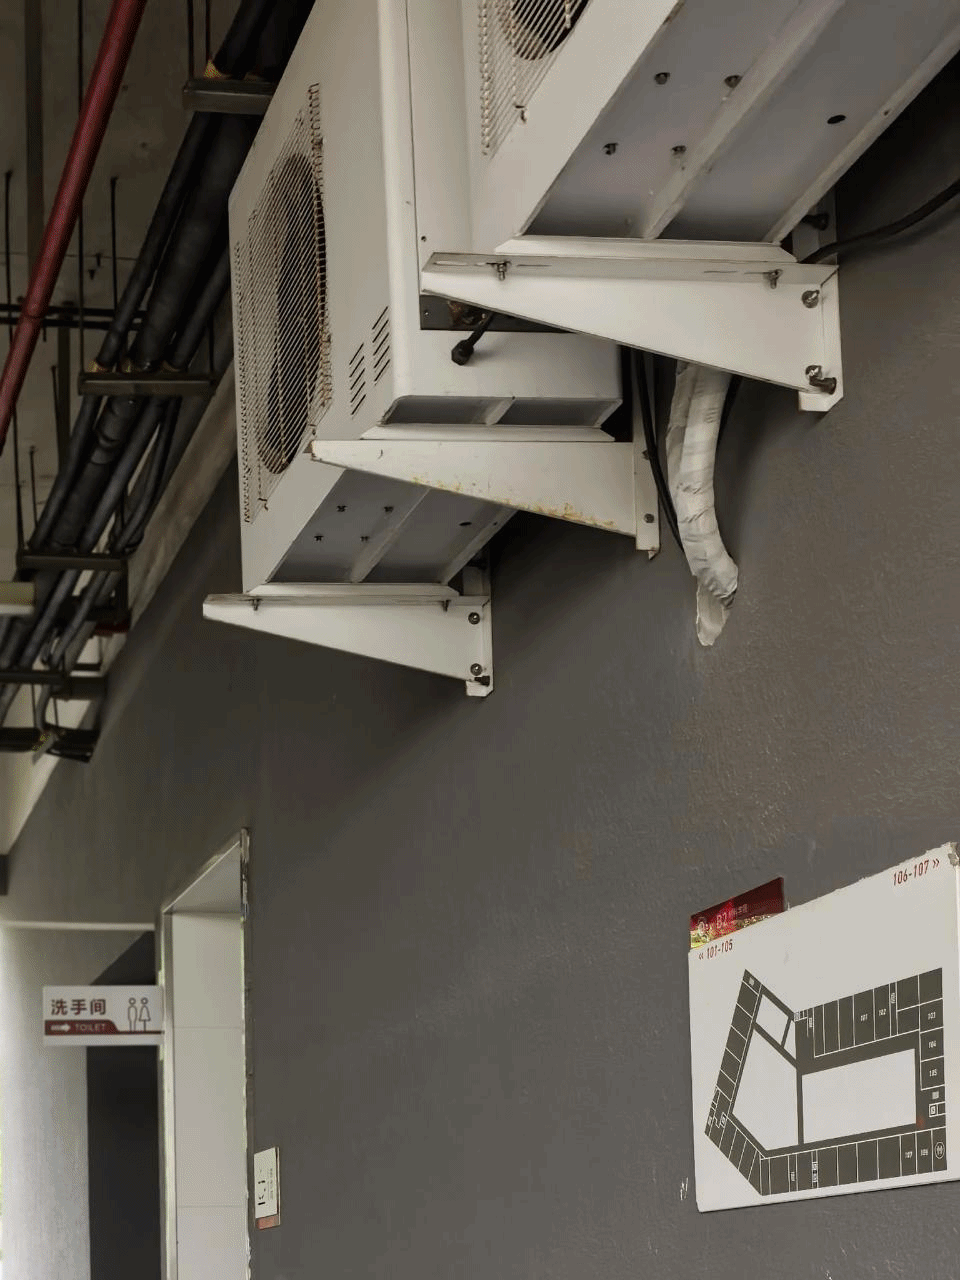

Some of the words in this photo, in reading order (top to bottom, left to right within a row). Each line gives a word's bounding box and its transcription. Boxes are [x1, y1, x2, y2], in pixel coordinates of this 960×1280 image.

[893, 859, 929, 886] 106-107
[51, 998, 106, 1015] 洗手间
[74, 1023, 106, 1032] TOILET
